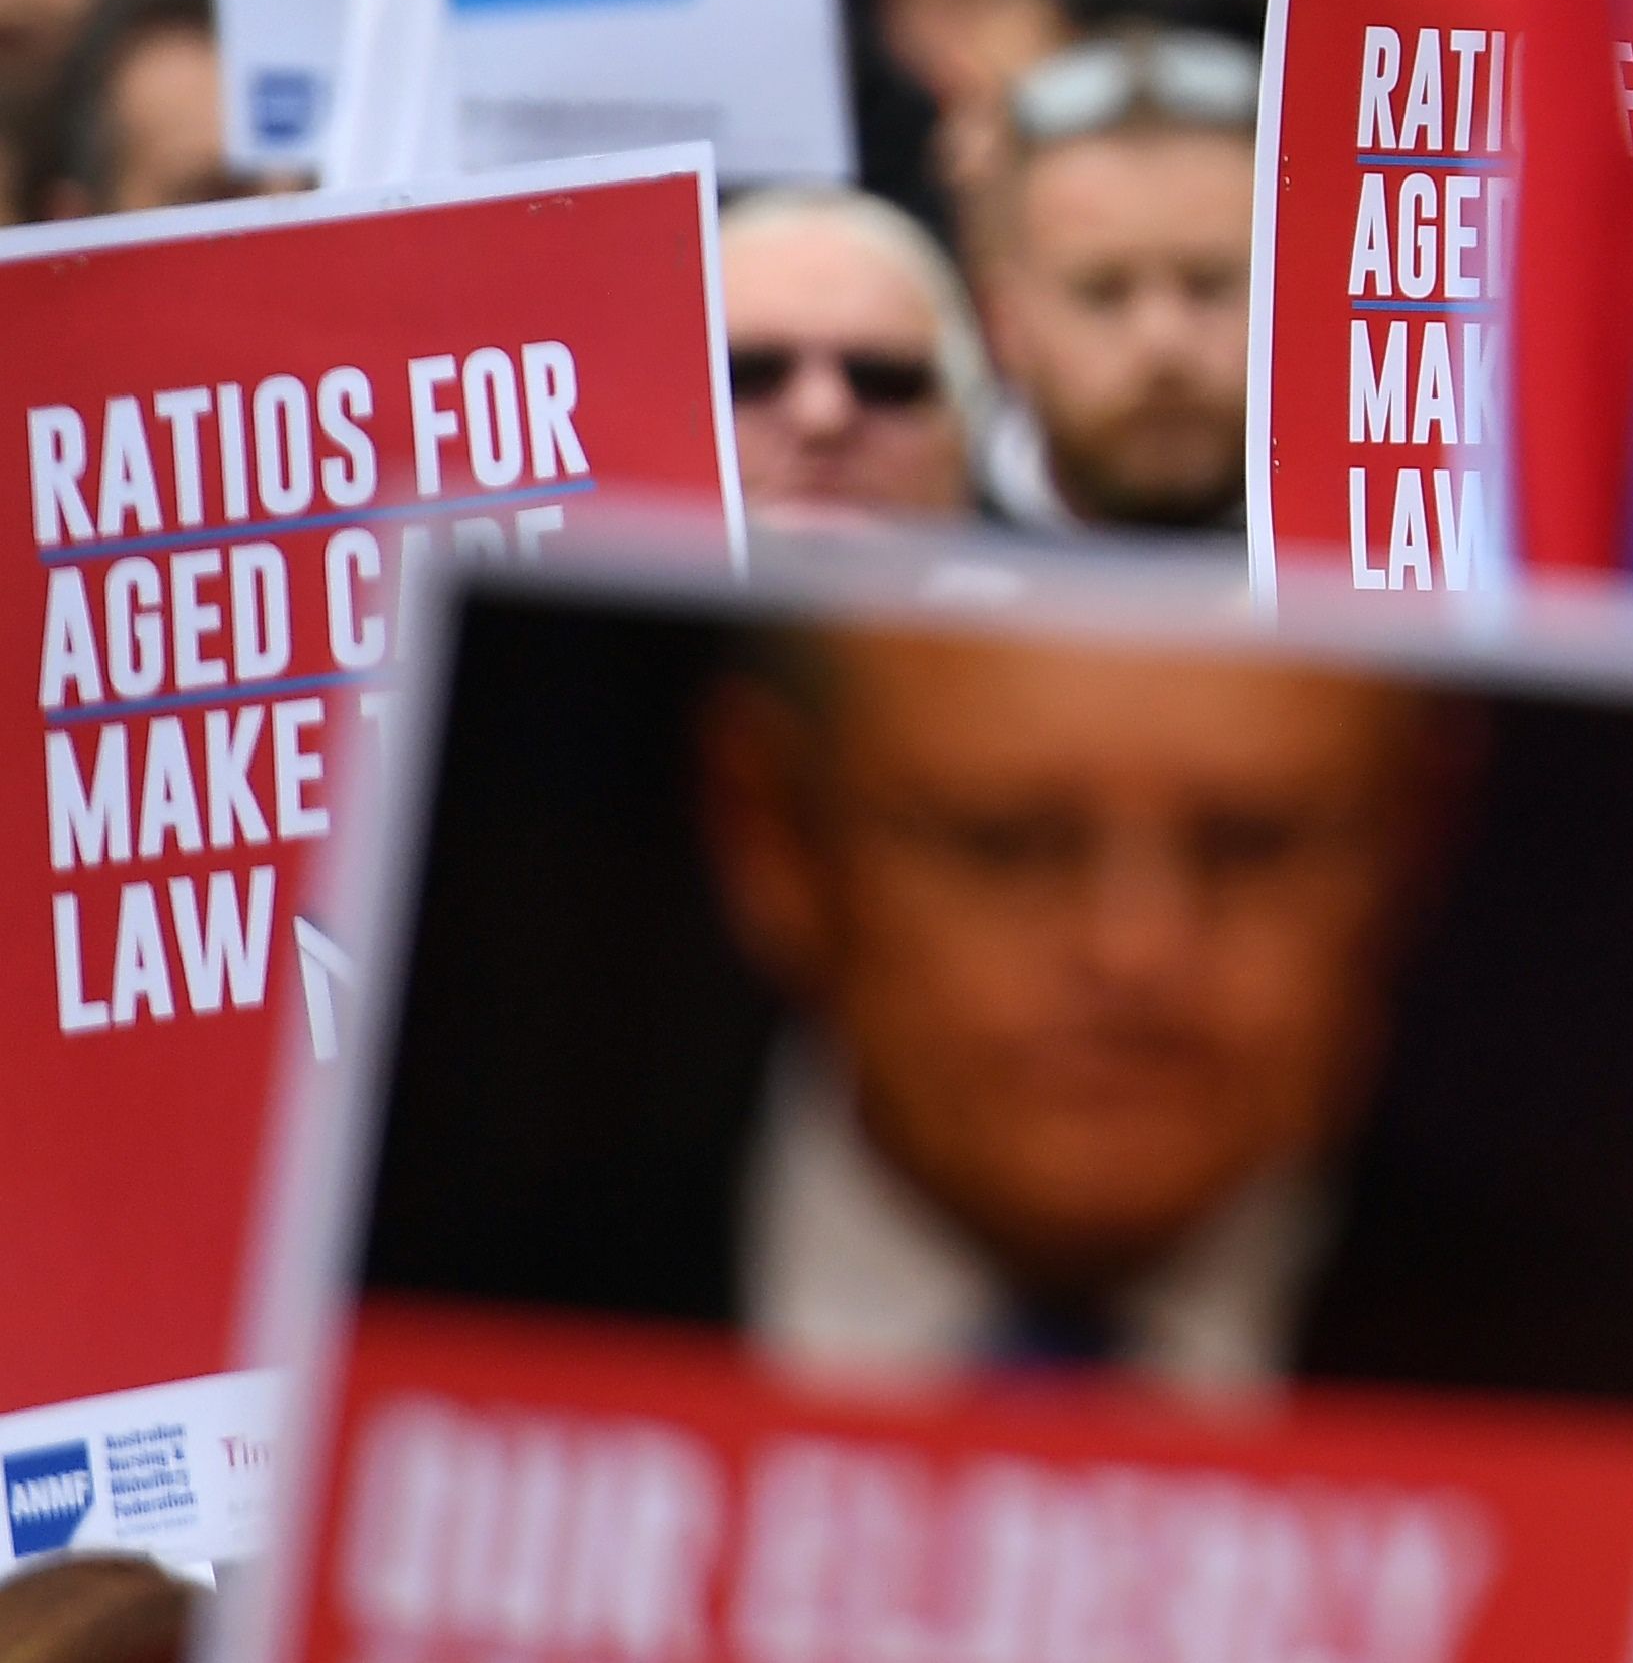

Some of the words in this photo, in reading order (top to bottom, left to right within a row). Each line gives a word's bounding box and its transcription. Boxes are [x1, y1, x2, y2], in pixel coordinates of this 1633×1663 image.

[1356, 24, 1522, 152] RATI
[26, 364, 377, 548] RATIOS
[408, 340, 591, 495] FOR
[1349, 319, 1505, 445] MAK
[39, 540, 291, 712] AGED
[44, 697, 330, 870] MAKE
[50, 864, 275, 1037] LAW
[10, 1468, 90, 1518] ANMF
